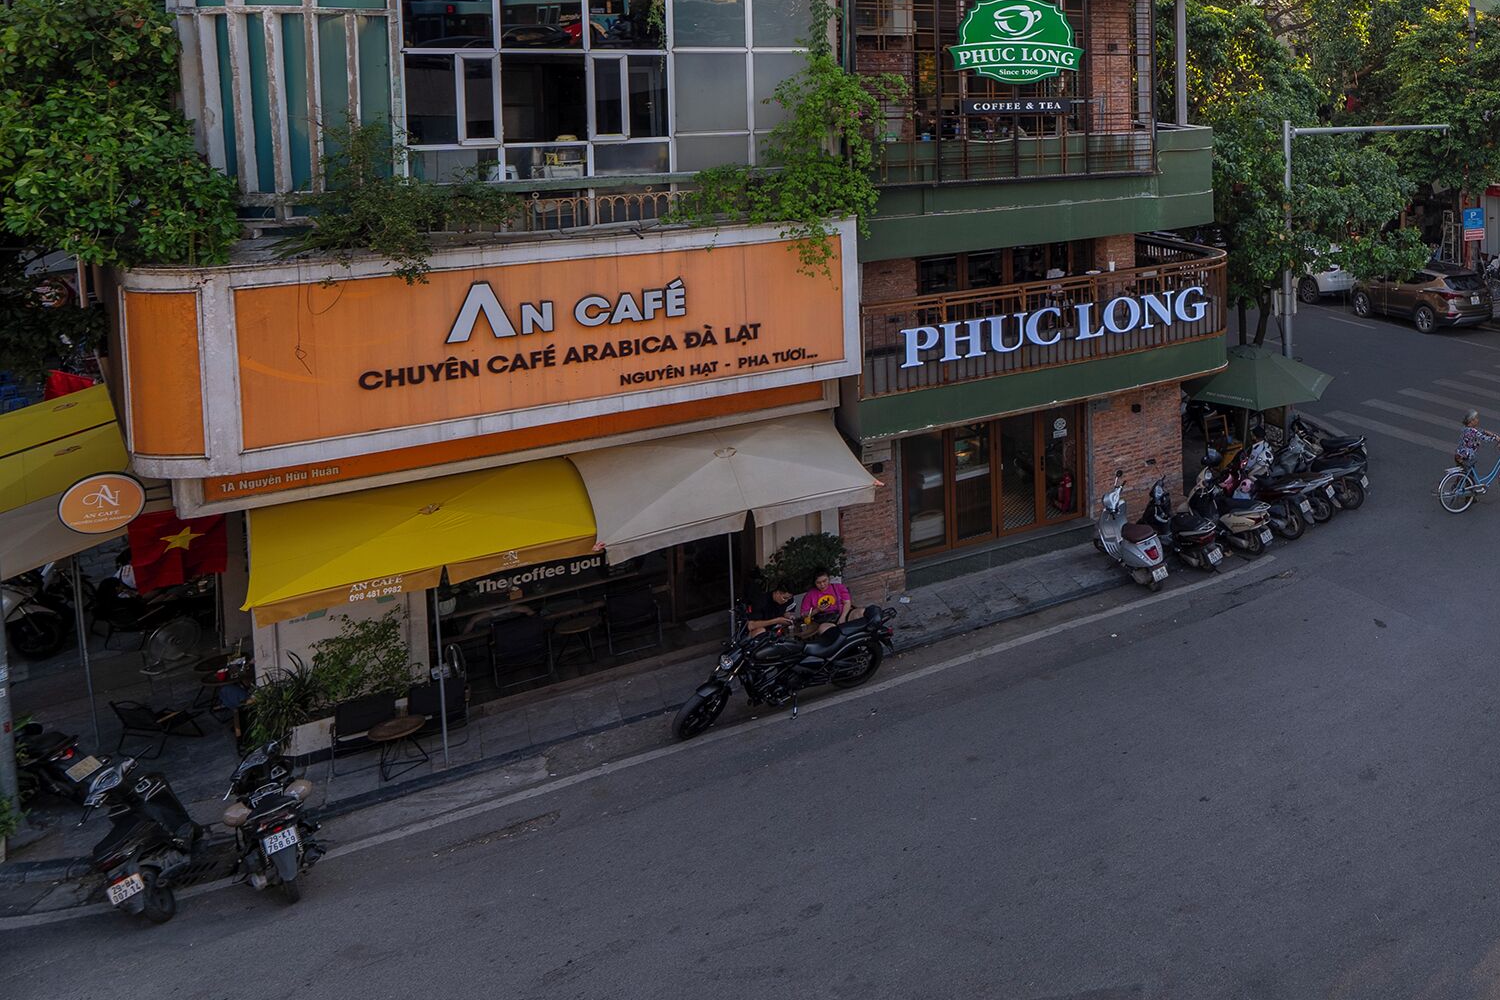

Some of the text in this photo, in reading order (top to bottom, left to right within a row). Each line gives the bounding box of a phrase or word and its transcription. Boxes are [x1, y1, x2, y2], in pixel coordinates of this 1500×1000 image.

[958, 47, 1075, 66] PHUC LONG
[973, 101, 1061, 111] COFFEE & TEA
[573, 276, 687, 328] CAFÉ
[900, 286, 1209, 369] PHUC LONG
[358, 322, 762, 390] CHUYÊN CAFÉ ARABICA ĐÀ LẠT
[619, 364, 685, 386] NGUYÊN
[690, 360, 719, 377] HẠT
[738, 355, 770, 369] PHA
[221, 482, 235, 493] 1A
[311, 466, 339, 478] Huân
[350, 582, 369, 593] AN
[476, 579, 508, 593] The
[512, 565, 565, 585] coffee
[570, 557, 601, 575] you
[349, 592, 365, 602] 098
[366, 589, 380, 598] 481
